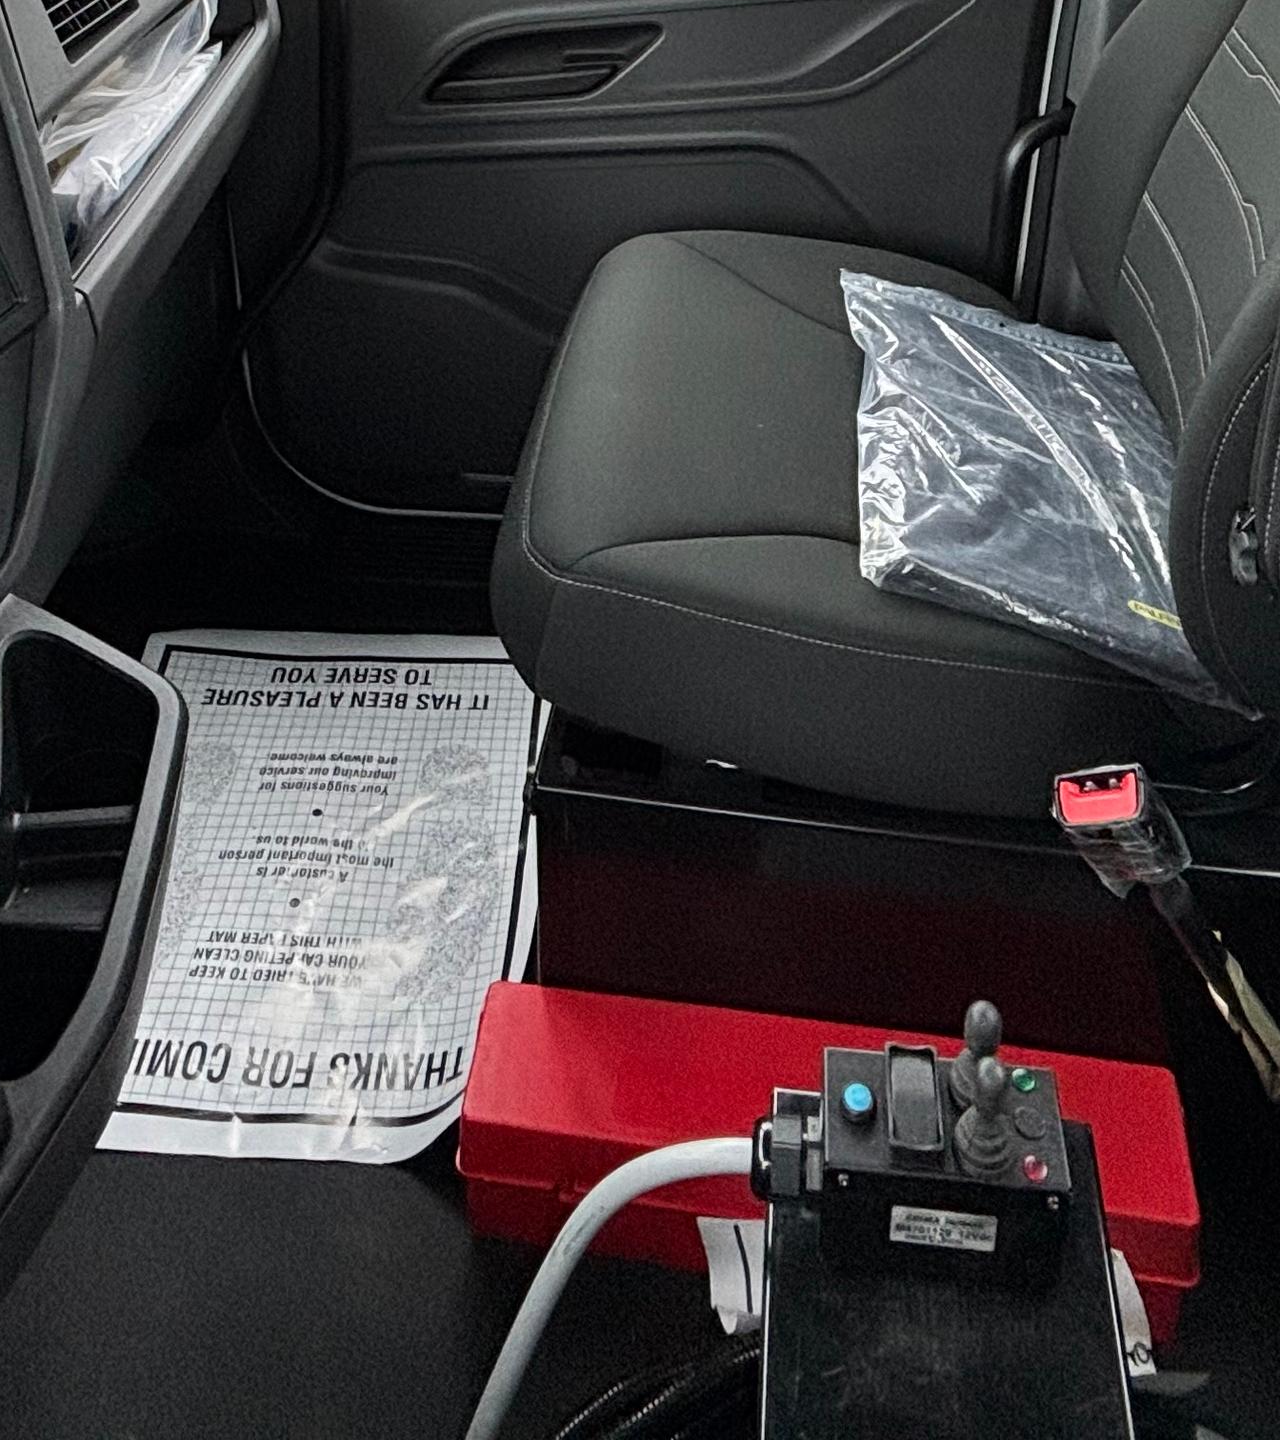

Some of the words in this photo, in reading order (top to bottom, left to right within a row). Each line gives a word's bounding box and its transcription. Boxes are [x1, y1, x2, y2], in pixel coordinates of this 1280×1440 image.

[270, 666, 317, 684] YOU
[324, 667, 398, 685] SERVE
[403, 669, 433, 686] TO
[201, 687, 322, 709] PLEASURE
[330, 691, 345, 708] A
[348, 691, 409, 709] BEEN
[415, 693, 462, 711] HAS
[468, 694, 491, 710] IT
[330, 751, 374, 766] always
[376, 755, 399, 766] are
[259, 766, 306, 777] service
[308, 768, 330, 777] our
[331, 768, 397, 781] improving
[257, 781, 277, 793] for
[280, 780, 359, 794] suggestions
[359, 783, 390, 796] Your
[274, 834, 289, 846] to
[291, 835, 329, 847] world
[332, 838, 354, 851] the
[218, 849, 264, 861] person
[267, 849, 332, 866] important
[372, 857, 395, 869] the
[256, 866, 268, 876] is
[338, 871, 349, 883] A
[206, 930, 238, 944] MAT
[289, 934, 322, 948] THIS
[194, 947, 240, 961] CLEAN
[327, 954, 369, 969] YOUR
[189, 964, 226, 979] KEEP
[229, 966, 248, 981] TO
[340, 973, 363, 988] WE
[133, 1037, 233, 1084] COMI
[241, 1046, 318, 1089] FOR
